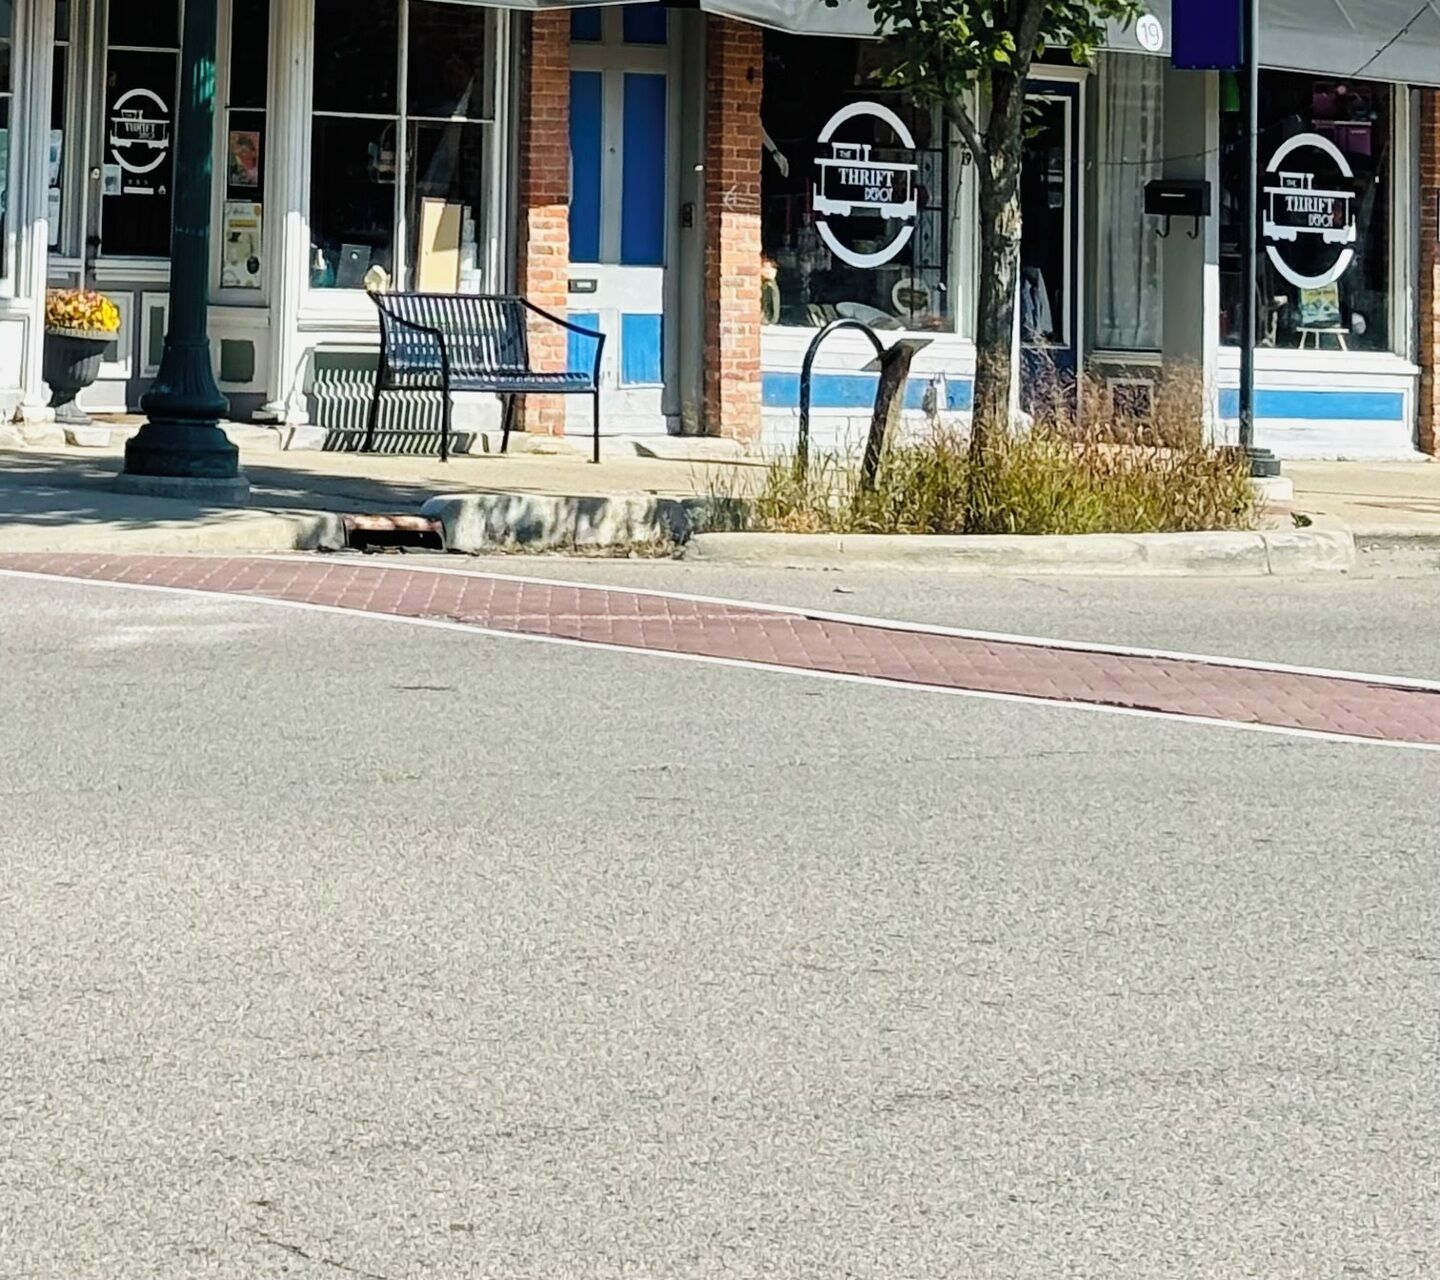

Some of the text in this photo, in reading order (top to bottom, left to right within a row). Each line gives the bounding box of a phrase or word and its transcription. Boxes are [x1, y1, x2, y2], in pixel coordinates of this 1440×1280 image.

[1141, 22, 1160, 46] 19
[838, 167, 895, 187] THRIFT
[864, 187, 894, 202] DEPOT
[1284, 195, 1335, 214] THRIFT
